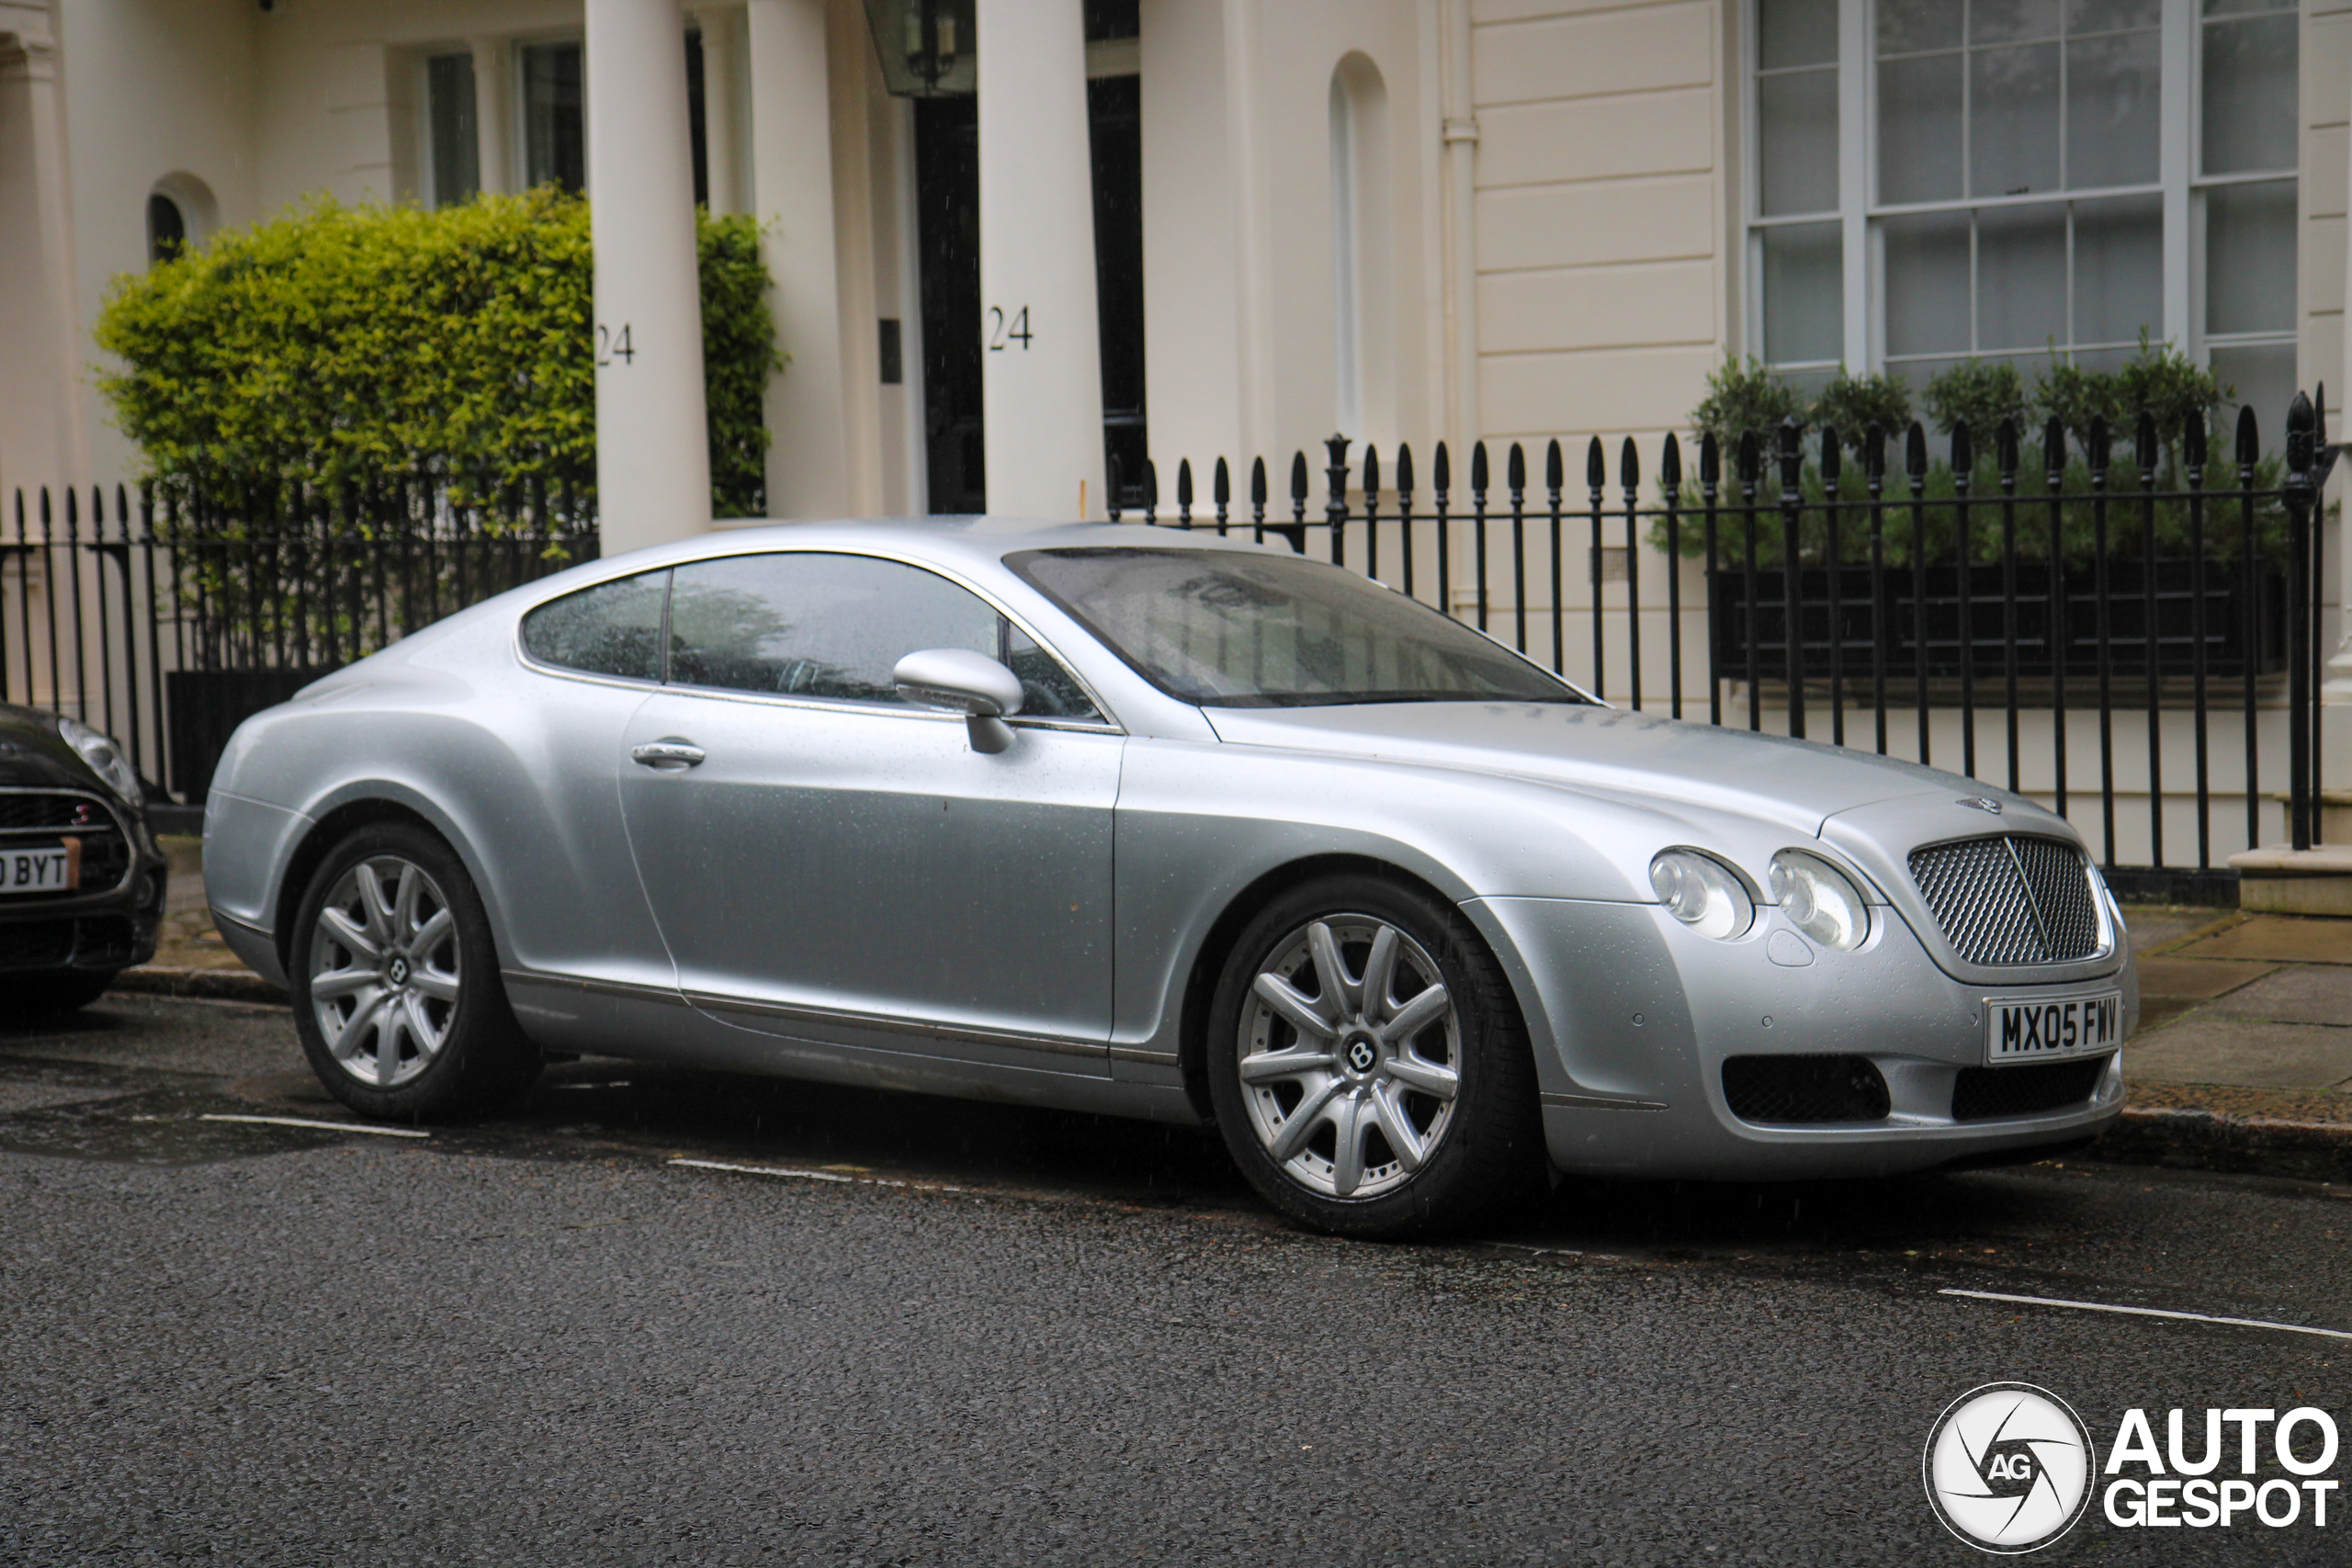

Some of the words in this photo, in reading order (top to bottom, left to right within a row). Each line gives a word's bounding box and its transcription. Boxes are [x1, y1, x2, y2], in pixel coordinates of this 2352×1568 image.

[596, 322, 636, 367] 24
[988, 304, 1034, 351] 24
[15, 854, 66, 886] BYT
[2001, 1004, 2077, 1052] MX05
